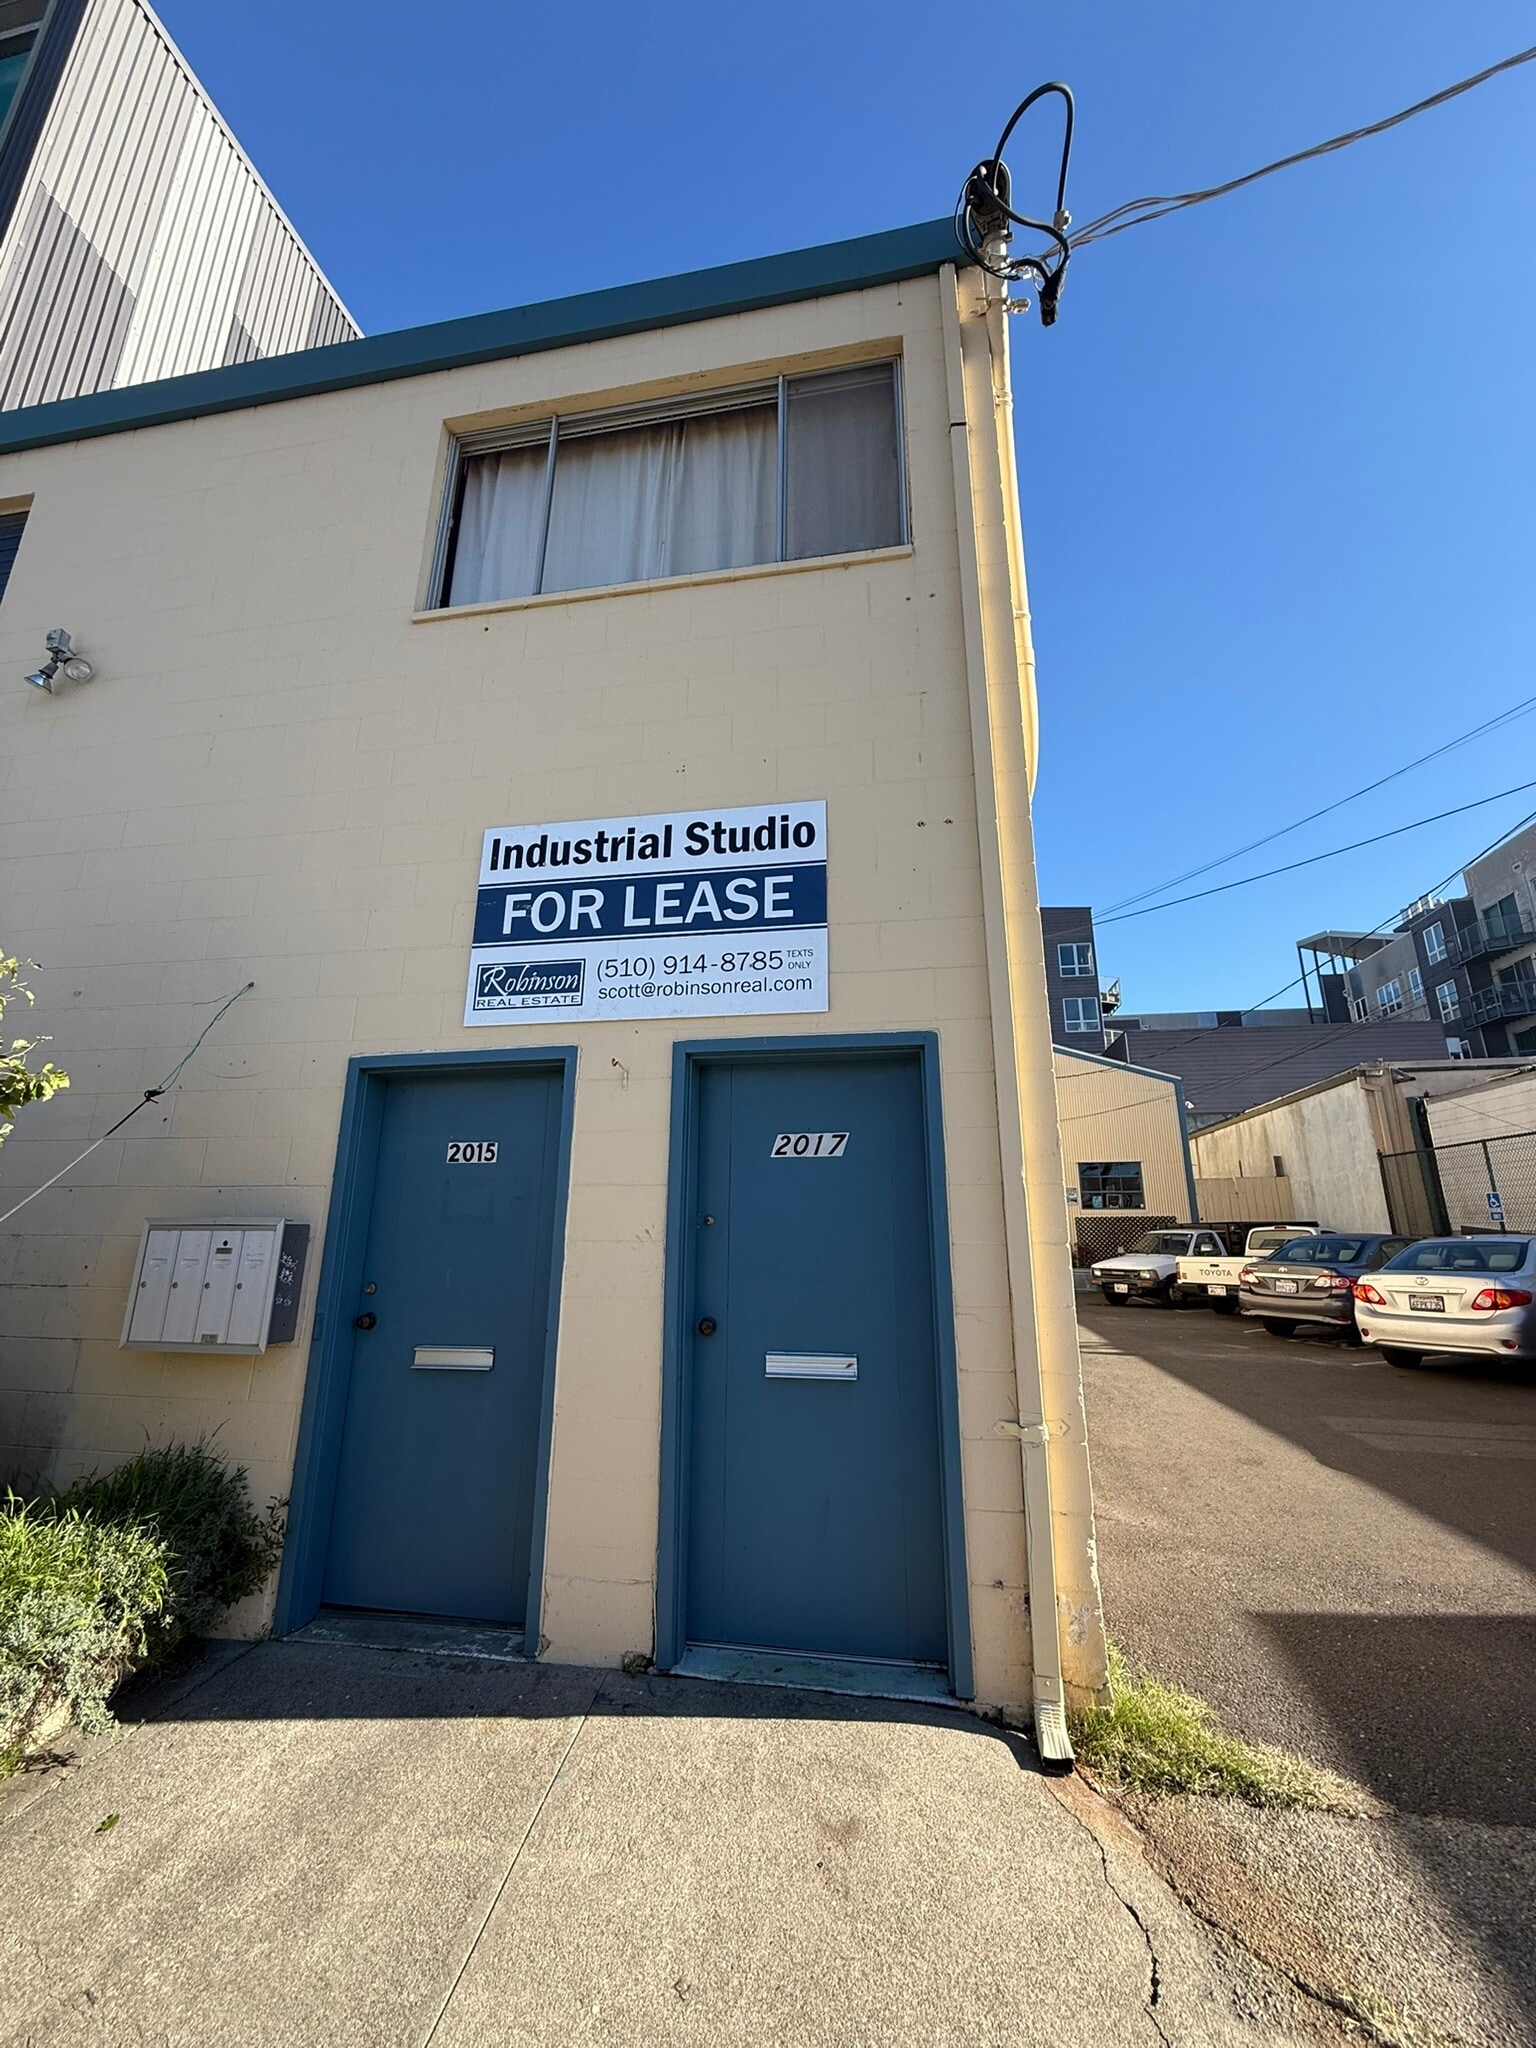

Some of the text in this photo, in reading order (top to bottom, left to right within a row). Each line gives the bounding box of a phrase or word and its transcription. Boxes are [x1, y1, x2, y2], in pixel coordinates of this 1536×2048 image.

[489, 814, 817, 872] Industrial Studio
[502, 874, 794, 935] FOR LEASE
[786, 948, 814, 959] TEXTS
[787, 960, 812, 970] ONLY
[596, 950, 784, 982] (510) 914-8785
[482, 964, 580, 997] Robinson
[598, 977, 813, 1000] scott@robinsonreal.com
[476, 994, 580, 1008] REAL ESTATE
[448, 1142, 496, 1163] 2015
[774, 1133, 847, 1156] 2017
[1199, 1269, 1233, 1277] TOYOTA
